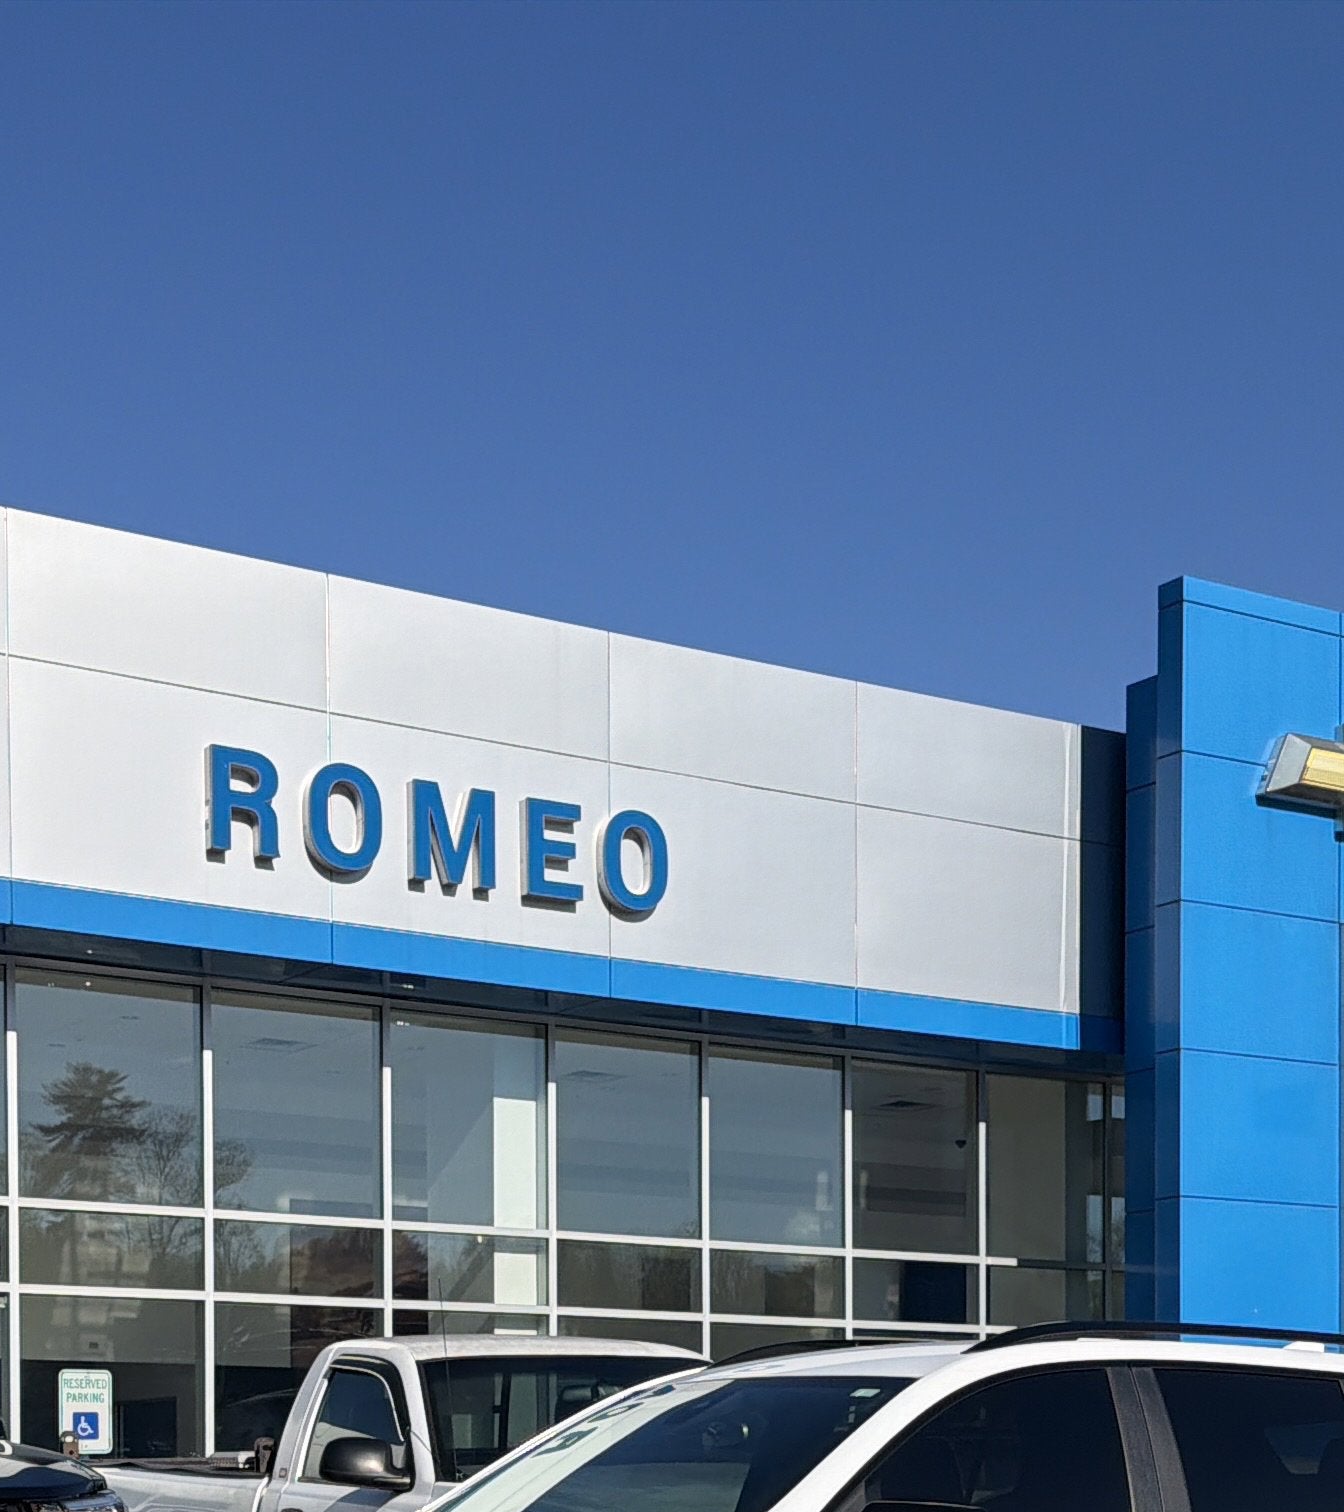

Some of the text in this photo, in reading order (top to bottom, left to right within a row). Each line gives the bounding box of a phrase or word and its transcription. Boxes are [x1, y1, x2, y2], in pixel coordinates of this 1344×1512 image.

[205, 744, 668, 911] ROMEO
[63, 1379, 108, 1390] RESERVED
[66, 1392, 105, 1404] PARKING
